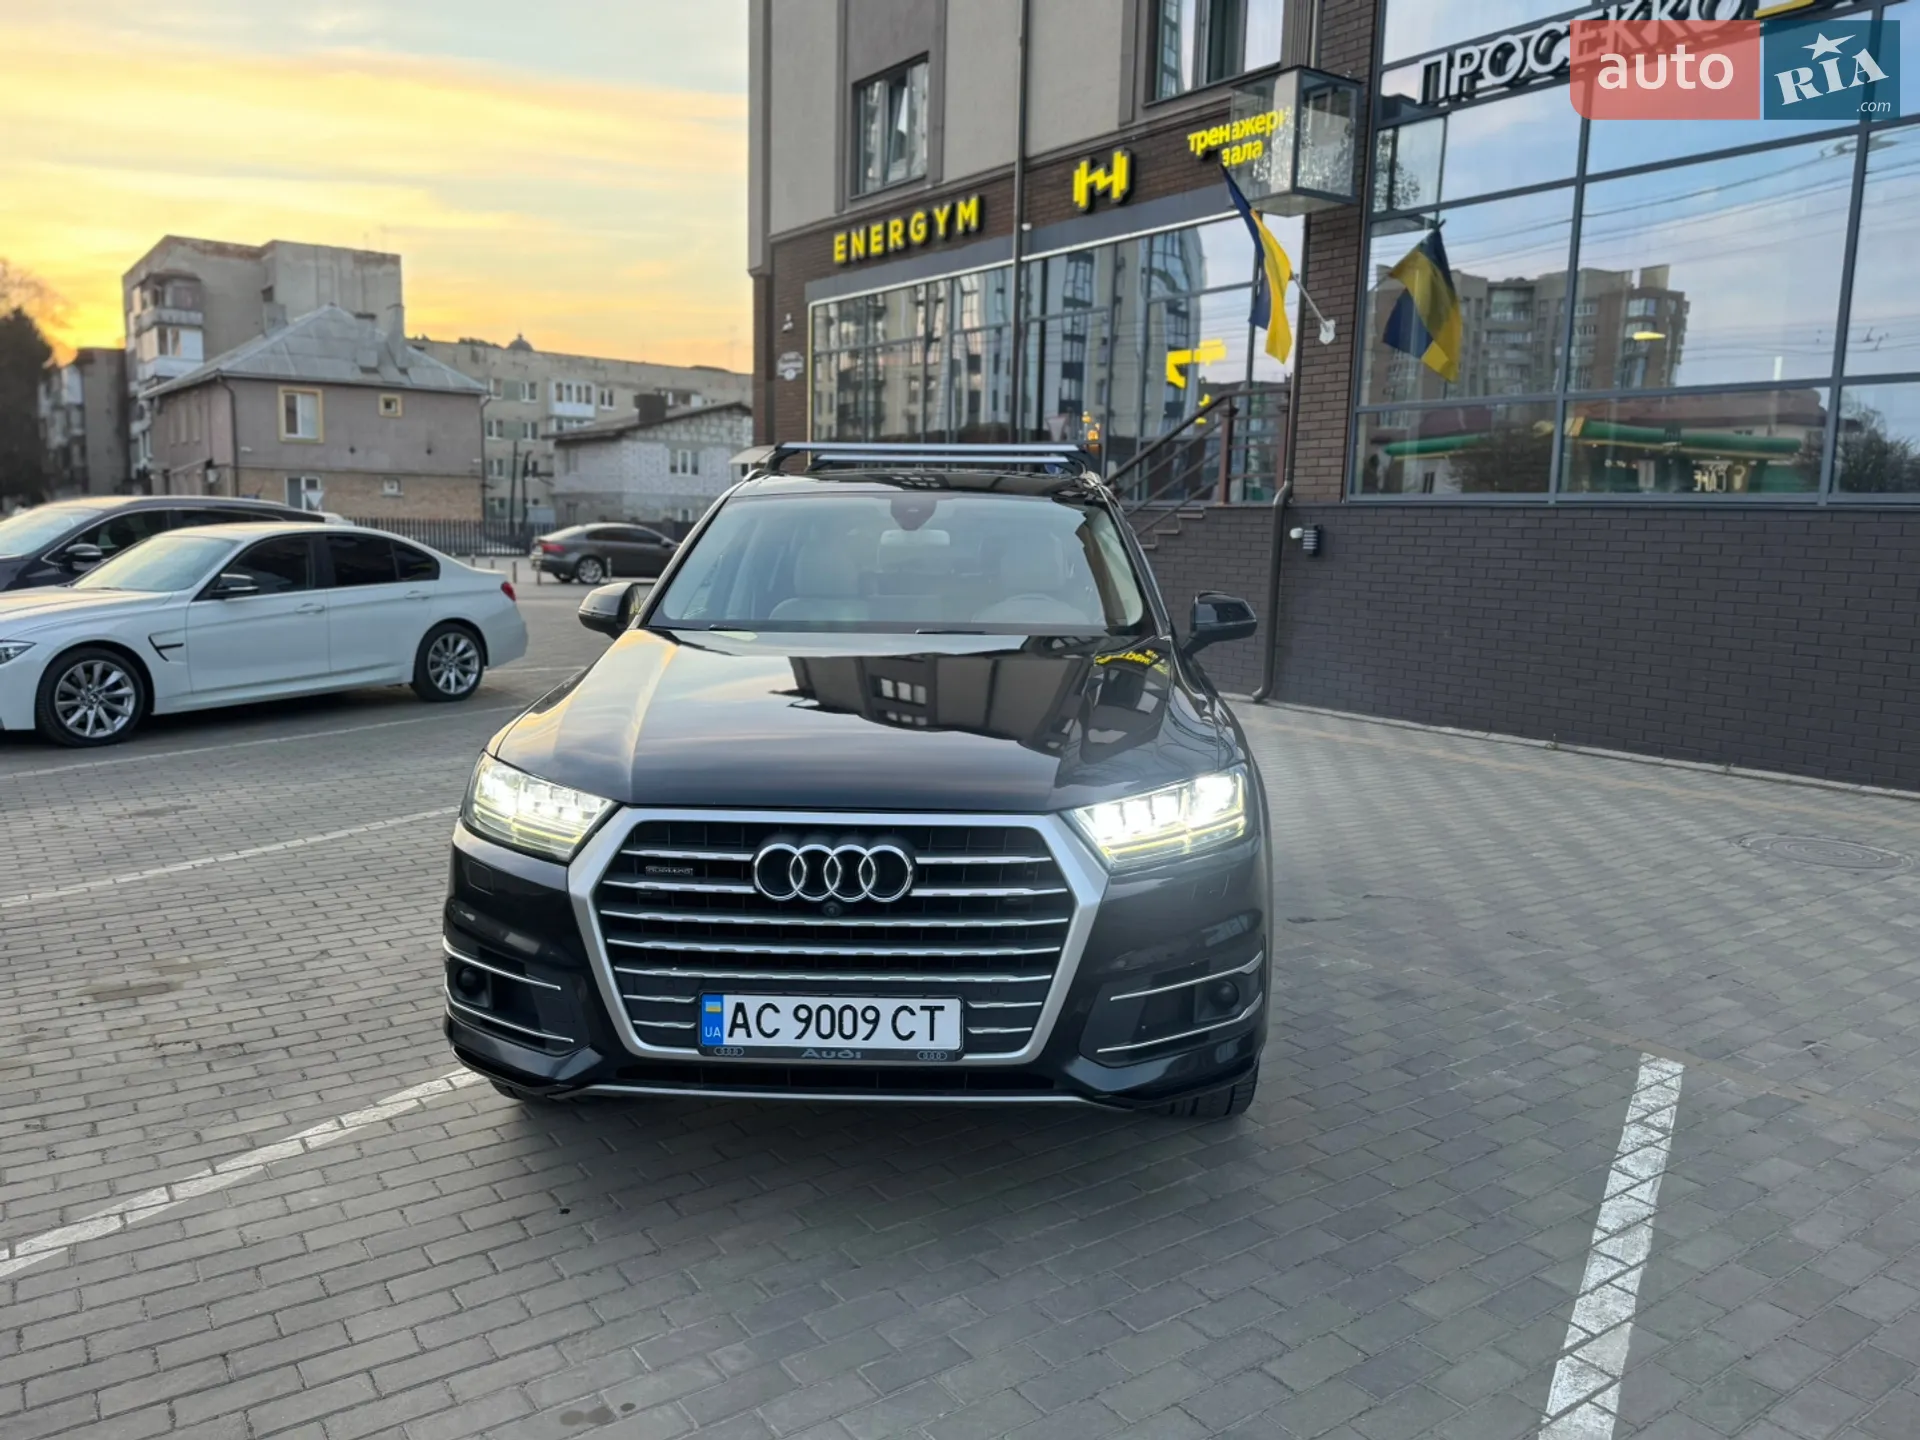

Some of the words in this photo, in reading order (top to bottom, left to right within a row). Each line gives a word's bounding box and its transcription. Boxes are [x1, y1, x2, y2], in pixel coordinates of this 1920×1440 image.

[1221, 140, 1264, 167] зала
[833, 194, 979, 264] ENERGYM
[704, 1026, 721, 1038] UA
[727, 1002, 781, 1039] AC
[792, 1004, 881, 1041] 9009
[890, 1005, 945, 1041] CT
